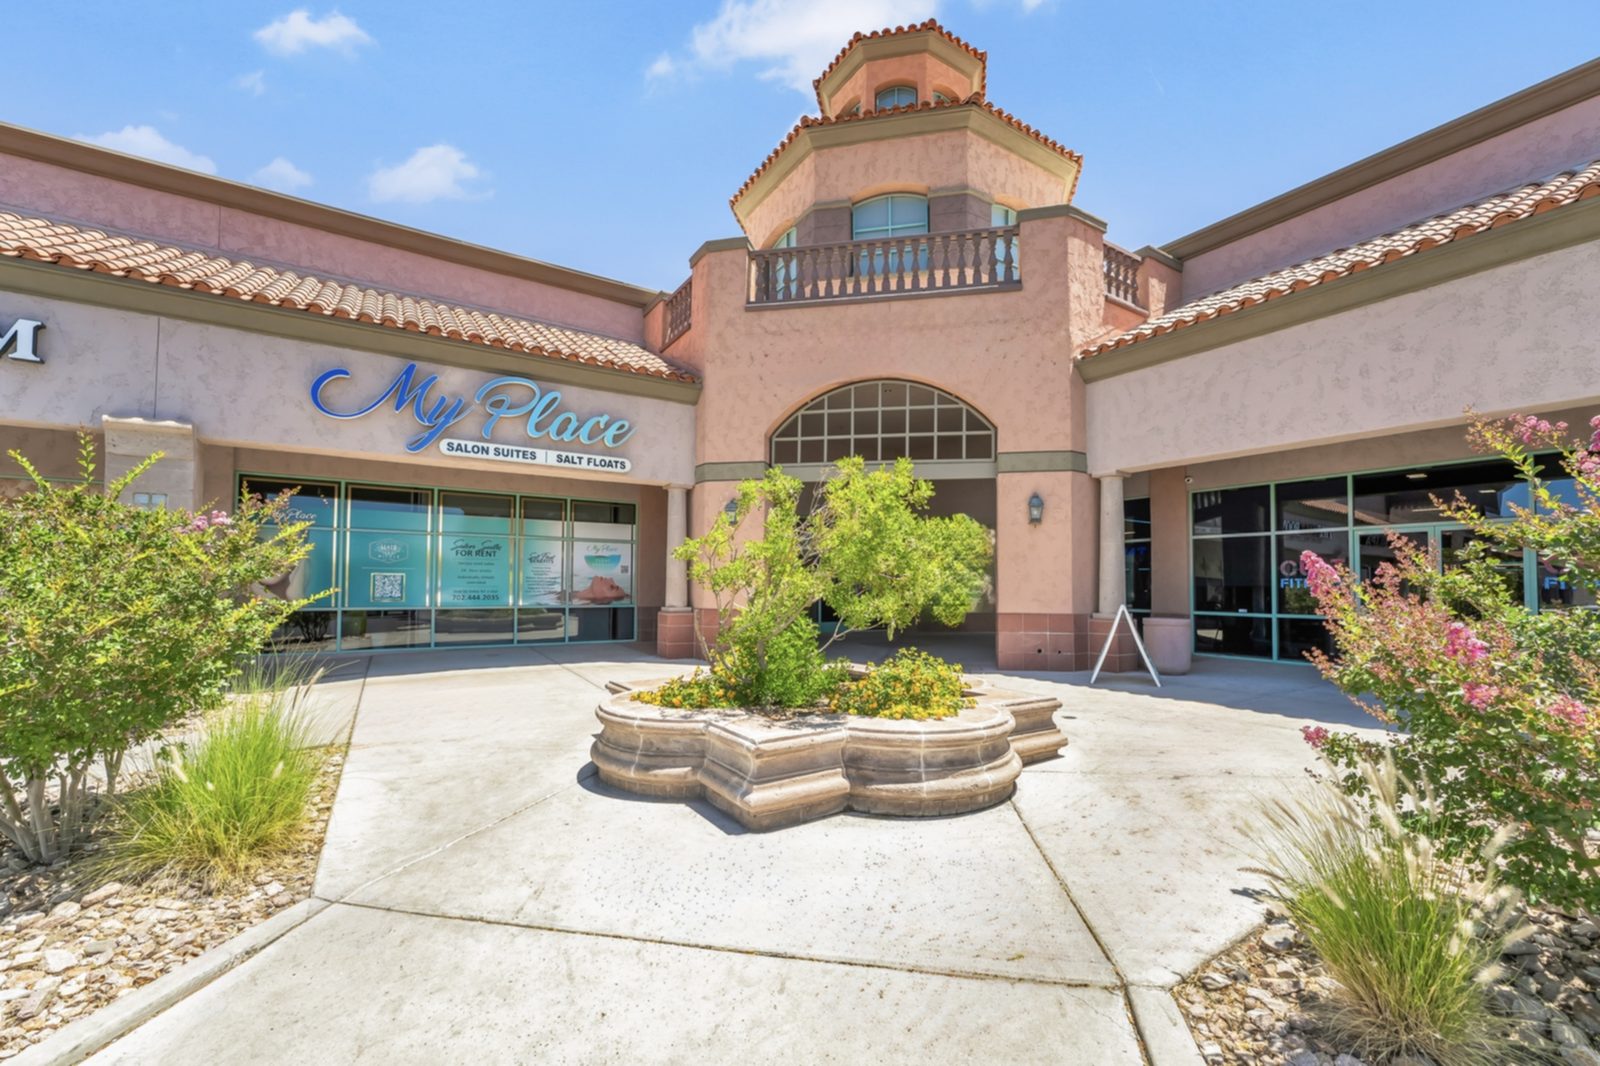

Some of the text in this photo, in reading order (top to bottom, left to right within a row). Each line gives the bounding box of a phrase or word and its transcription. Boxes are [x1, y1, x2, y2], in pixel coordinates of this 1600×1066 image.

[310, 363, 636, 452] My Place
[446, 441, 626, 470] SALON SUITES SALT FLOATS
[455, 549, 497, 558] FOR RENT
